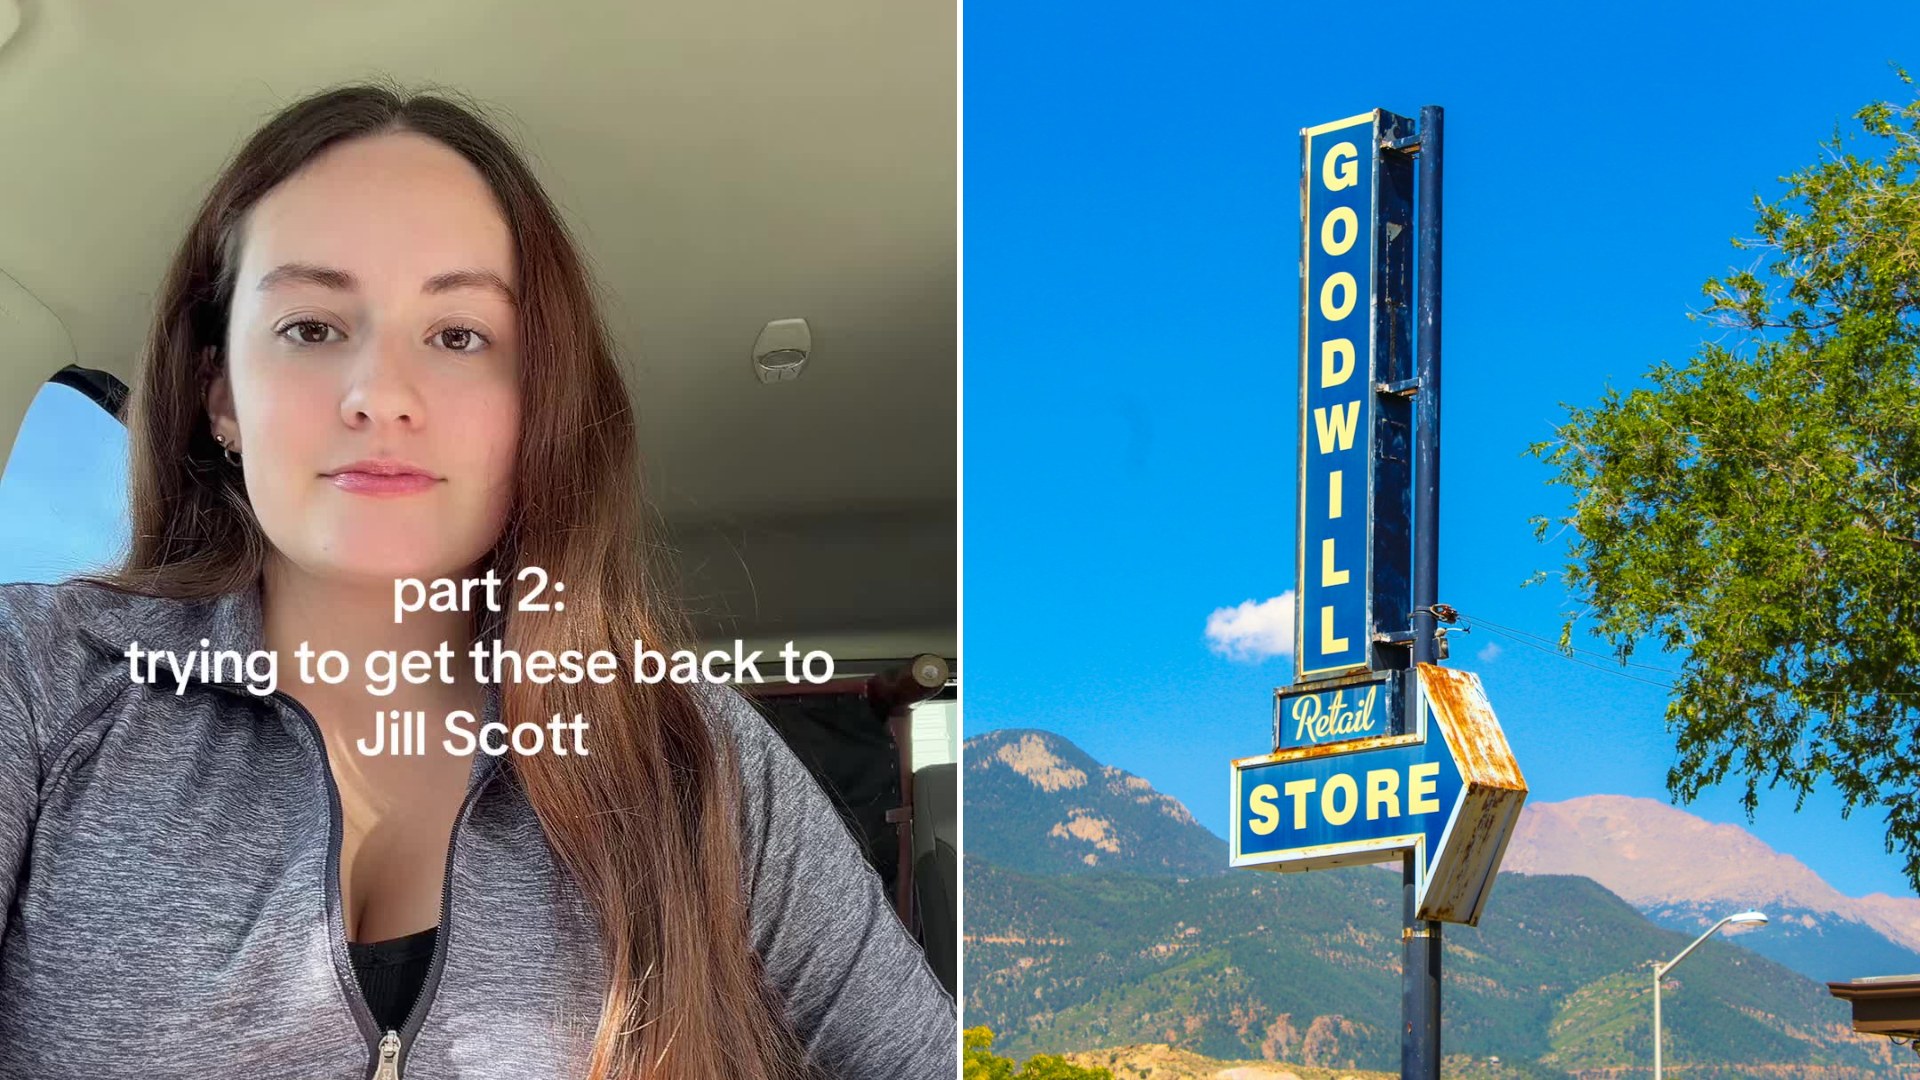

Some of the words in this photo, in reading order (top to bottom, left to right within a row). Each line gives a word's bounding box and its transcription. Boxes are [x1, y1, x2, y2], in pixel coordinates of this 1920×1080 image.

[1313, 141, 1361, 656] GOODWILL
[1292, 684, 1377, 743] Retail
[1248, 761, 1441, 836] STORE
